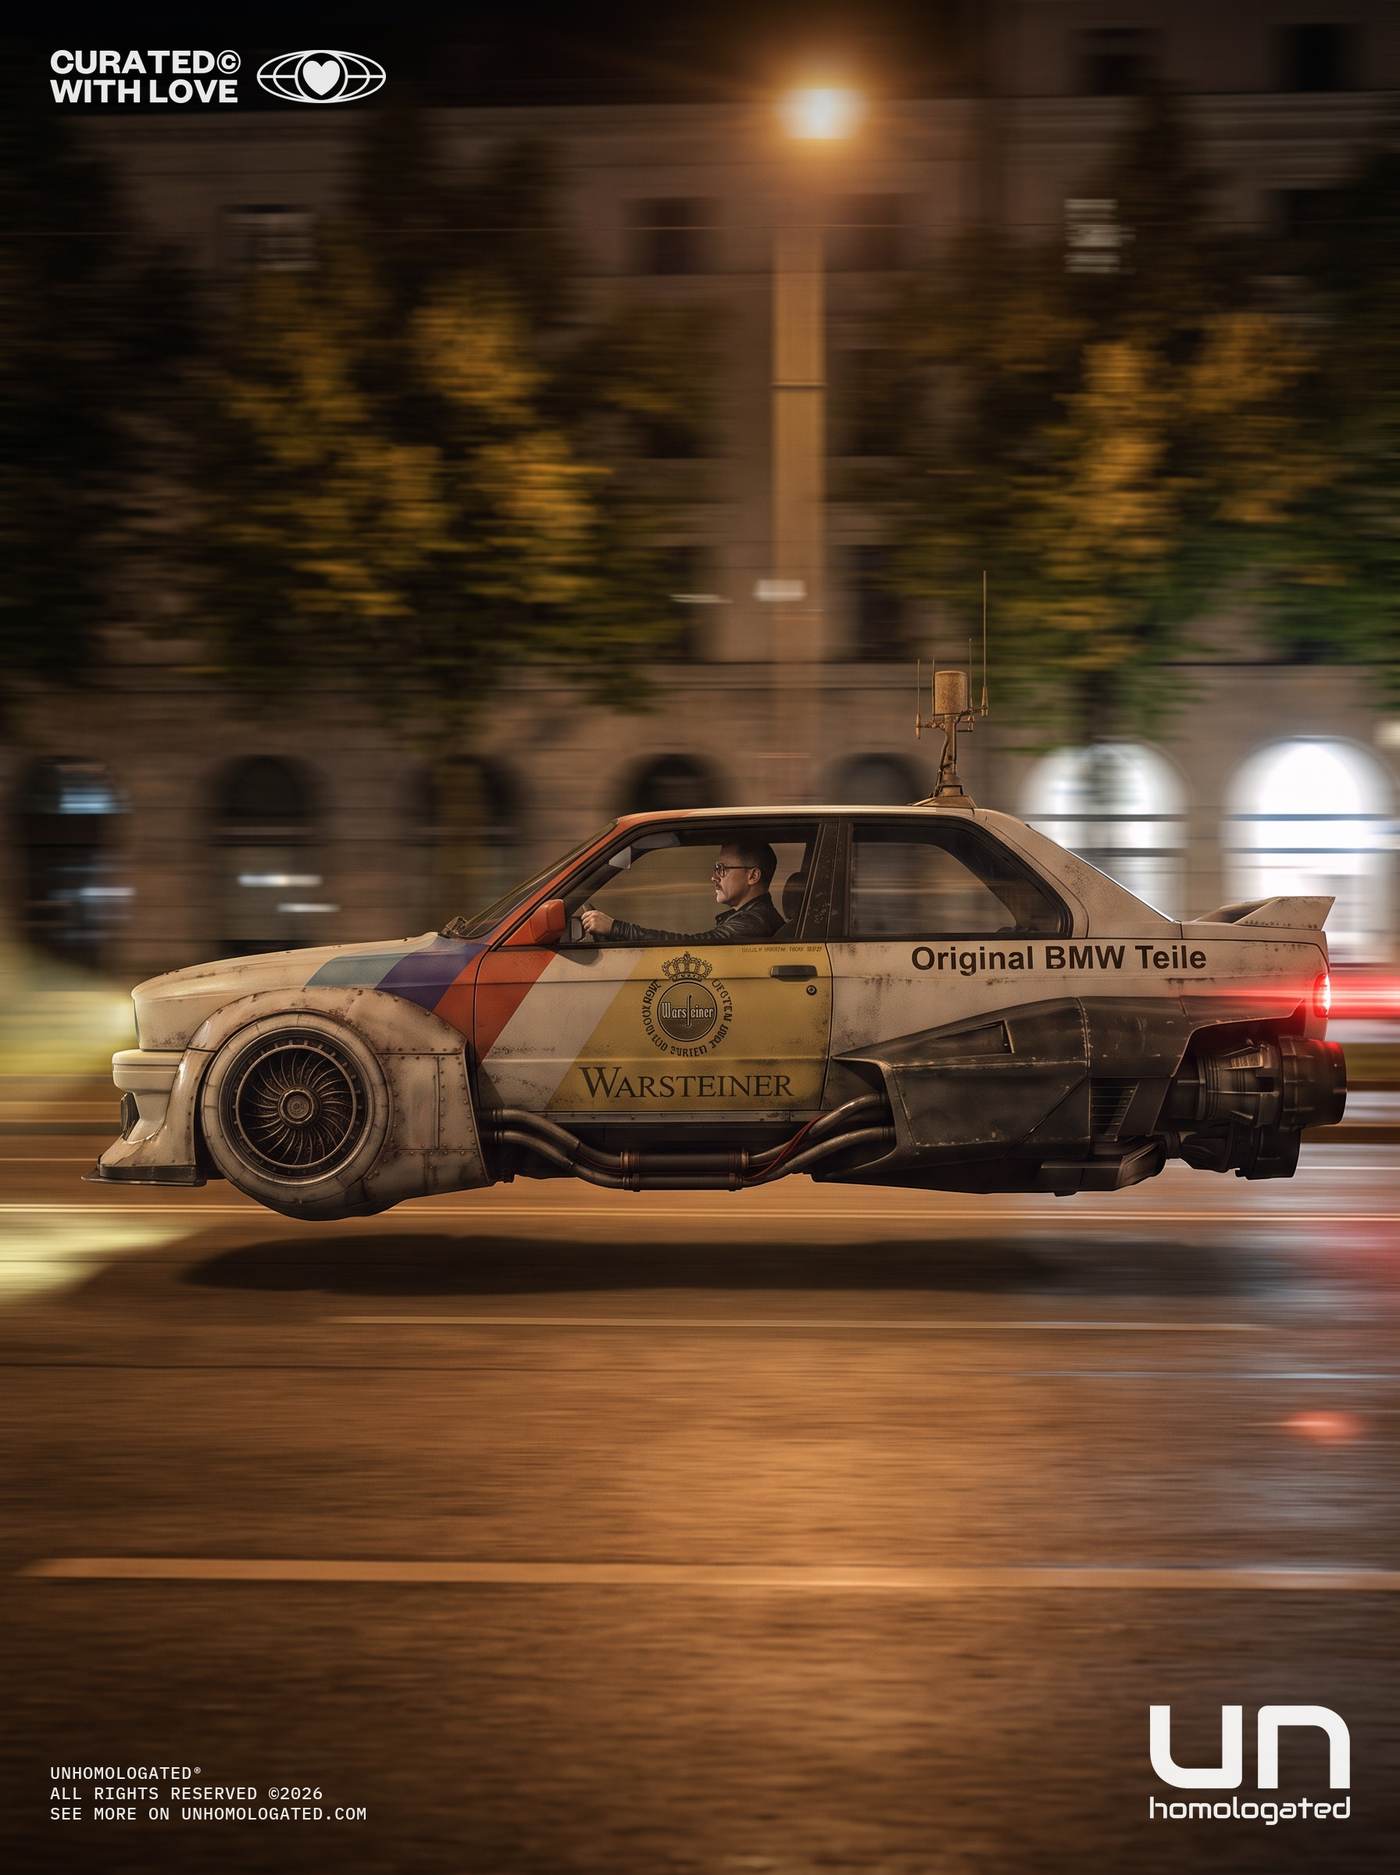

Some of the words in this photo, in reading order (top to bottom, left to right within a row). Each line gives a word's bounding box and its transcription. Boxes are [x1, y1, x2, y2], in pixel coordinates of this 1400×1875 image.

[911, 945, 1034, 976] Original
[1045, 945, 1126, 970] BMW
[1134, 944, 1207, 970] Teile
[579, 1066, 795, 1098] WARSTEINER
